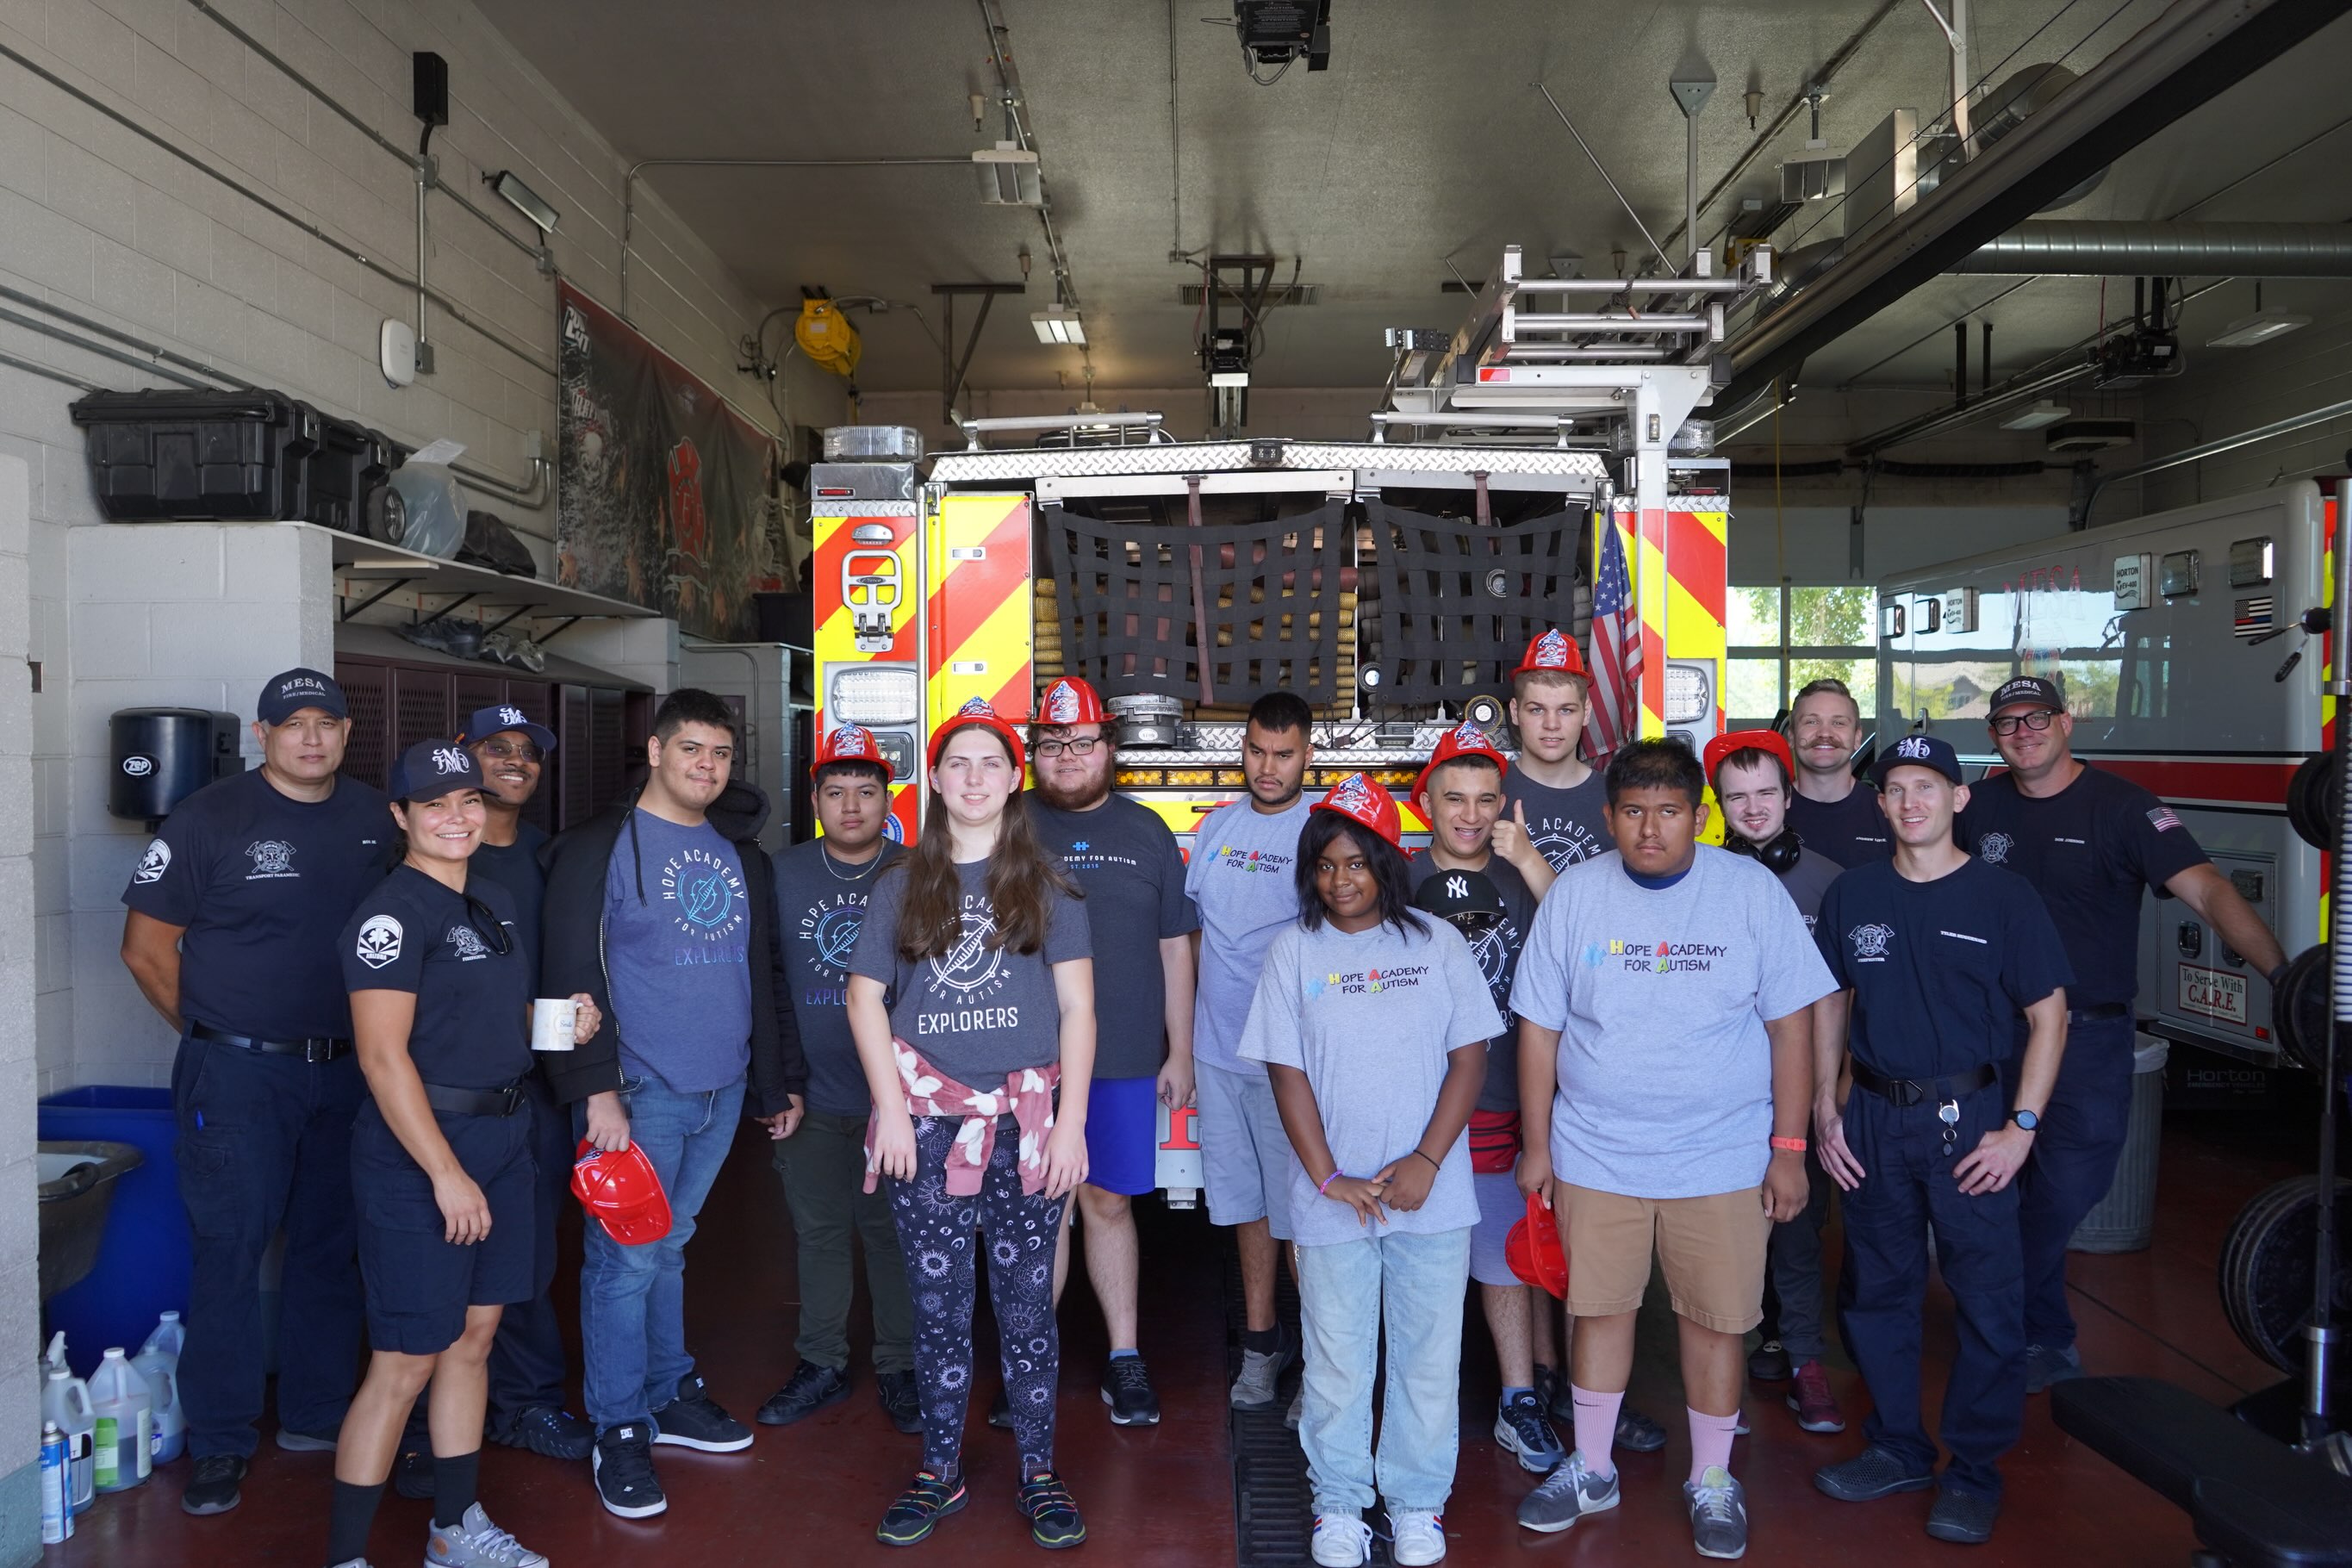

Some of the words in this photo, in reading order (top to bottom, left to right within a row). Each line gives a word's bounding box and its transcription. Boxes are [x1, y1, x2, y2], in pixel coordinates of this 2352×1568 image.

[2116, 567, 2139, 578] HORTON
[1947, 598, 1963, 607] HORTON
[281, 677, 326, 694] MESA
[2000, 680, 2042, 697] MESA
[283, 691, 326, 700] FIRE/MEDICAL
[2000, 690, 2042, 702] FIRE/MEDICAL
[1542, 818, 1602, 856] ACADEM
[1221, 845, 1248, 859] HOPE
[662, 857, 681, 899] HOPE
[683, 849, 745, 899] ACADEMY
[1226, 859, 1244, 868] FOR
[1245, 861, 1279, 874] ATISM
[675, 917, 694, 936] FOR
[799, 899, 830, 939] HOPE
[1609, 939, 1652, 956] HOPE
[1656, 940, 1727, 957] ACADEMY
[808, 957, 830, 978] FOR
[1624, 959, 1652, 972] FOR
[1656, 957, 1710, 974] AUTISM
[1328, 974, 1365, 985] HOPE
[1368, 966, 1429, 981] ACADEMY
[2182, 968, 2192, 981] To
[2194, 971, 2218, 987] Serve
[2220, 977, 2243, 993] With
[924, 975, 947, 1000] FOR
[956, 968, 1011, 1005] AUTISM
[1342, 985, 1366, 993] FOR
[1371, 978, 1419, 993] AUTISM
[2188, 984, 2237, 1012] C.A.R.E.
[918, 1006, 1019, 1035] EXPLORERS
[2187, 1069, 2266, 1082] Horton
